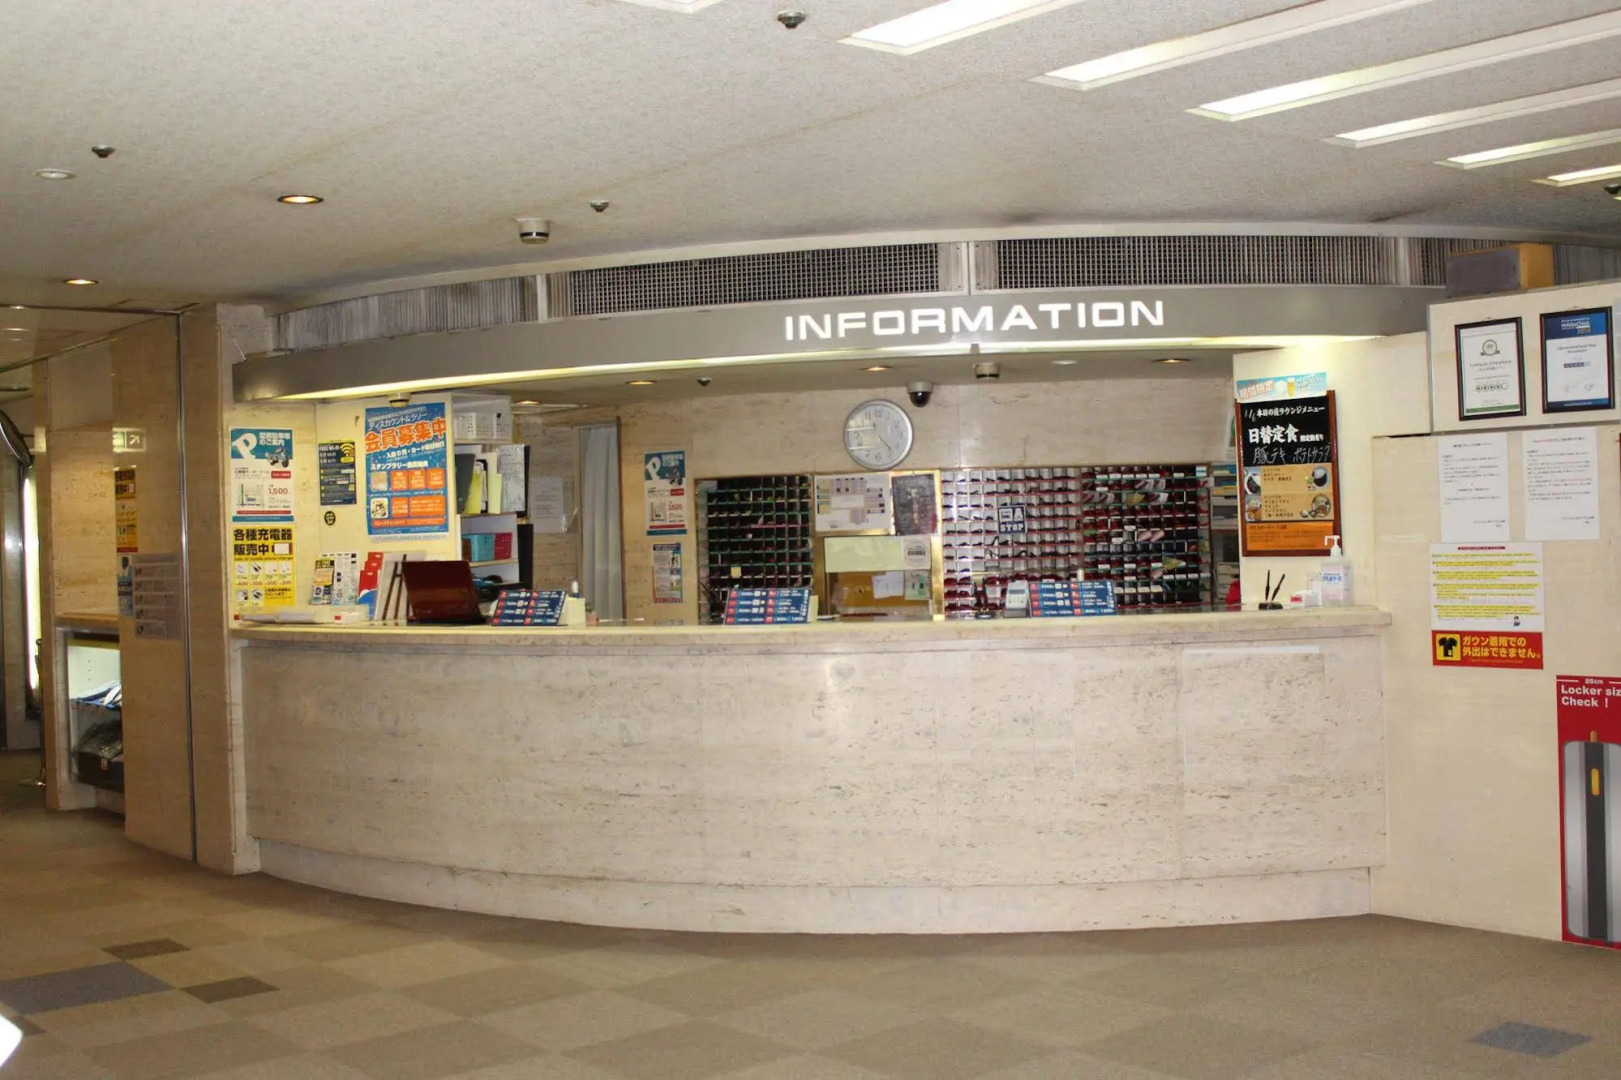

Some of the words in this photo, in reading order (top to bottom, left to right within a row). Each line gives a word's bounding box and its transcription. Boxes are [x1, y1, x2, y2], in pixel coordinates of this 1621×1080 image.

[785, 300, 1164, 341] INFORMATION
[365, 417, 447, 454] 会員募集中
[1248, 423, 1299, 444] 日替定食
[268, 487, 288, 495] 1,500
[233, 528, 292, 541] 各種充電器
[233, 543, 269, 556] 販売中
[1462, 635, 1527, 647] ガウン着用での
[1462, 646, 1541, 659] 外出はできません。
[1561, 684, 1602, 696] Locker
[1561, 696, 1599, 707] Check
